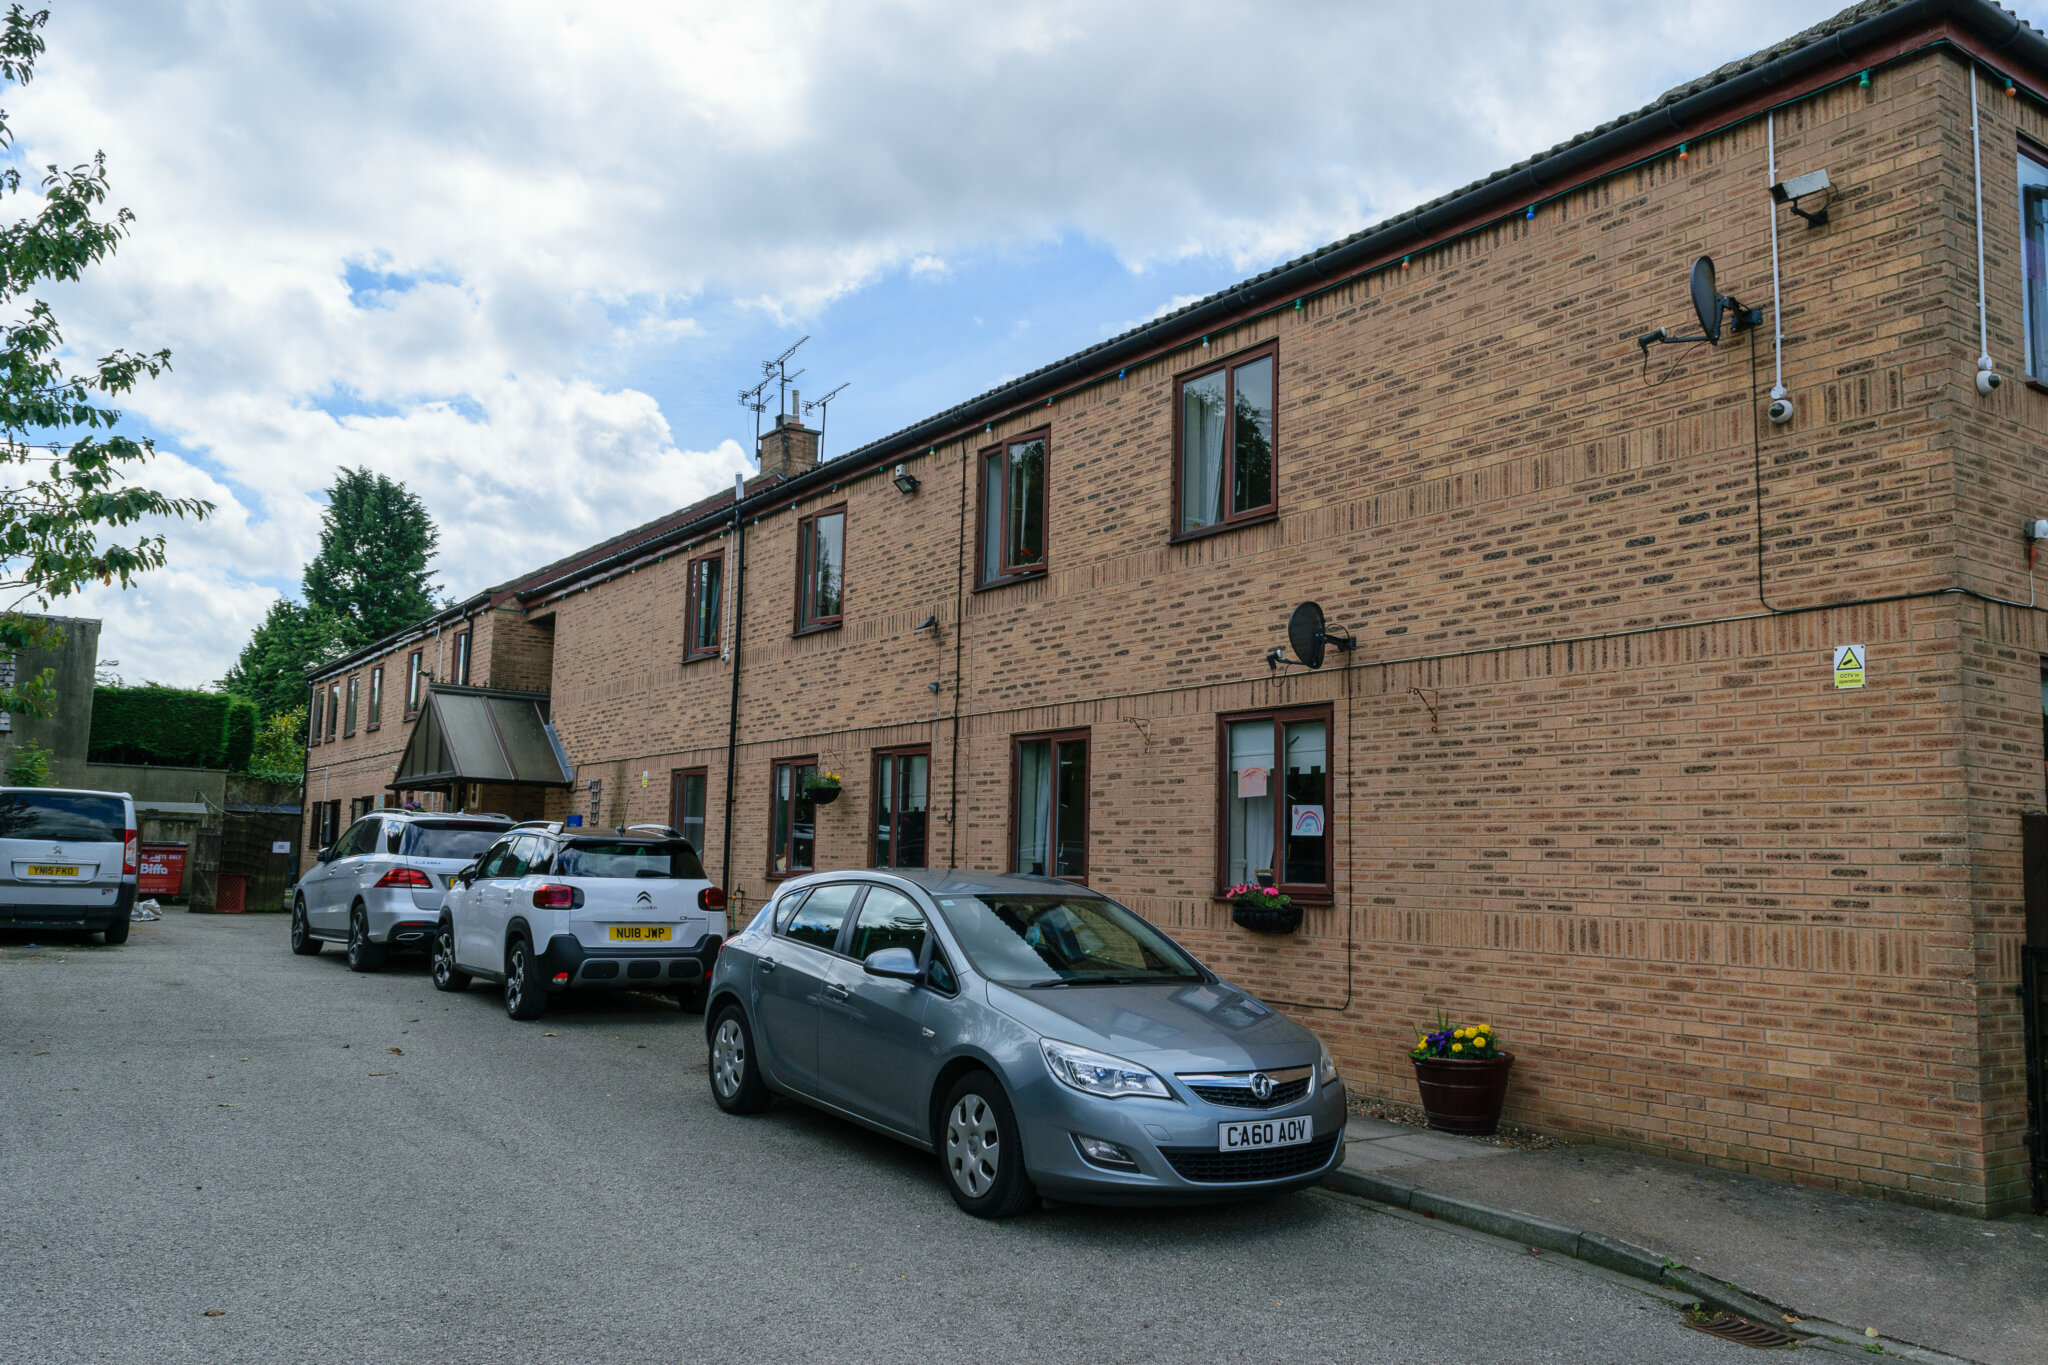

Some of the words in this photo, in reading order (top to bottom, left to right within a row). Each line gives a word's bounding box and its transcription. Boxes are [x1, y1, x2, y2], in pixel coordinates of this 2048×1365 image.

[34, 866, 53, 874] YN15
[56, 867, 73, 875] FKO
[140, 863, 168, 874] Biffa
[616, 928, 641, 938] NU18
[644, 928, 665, 938] JWP
[1228, 1124, 1273, 1147] CA60
[1278, 1120, 1305, 1143] AOV
